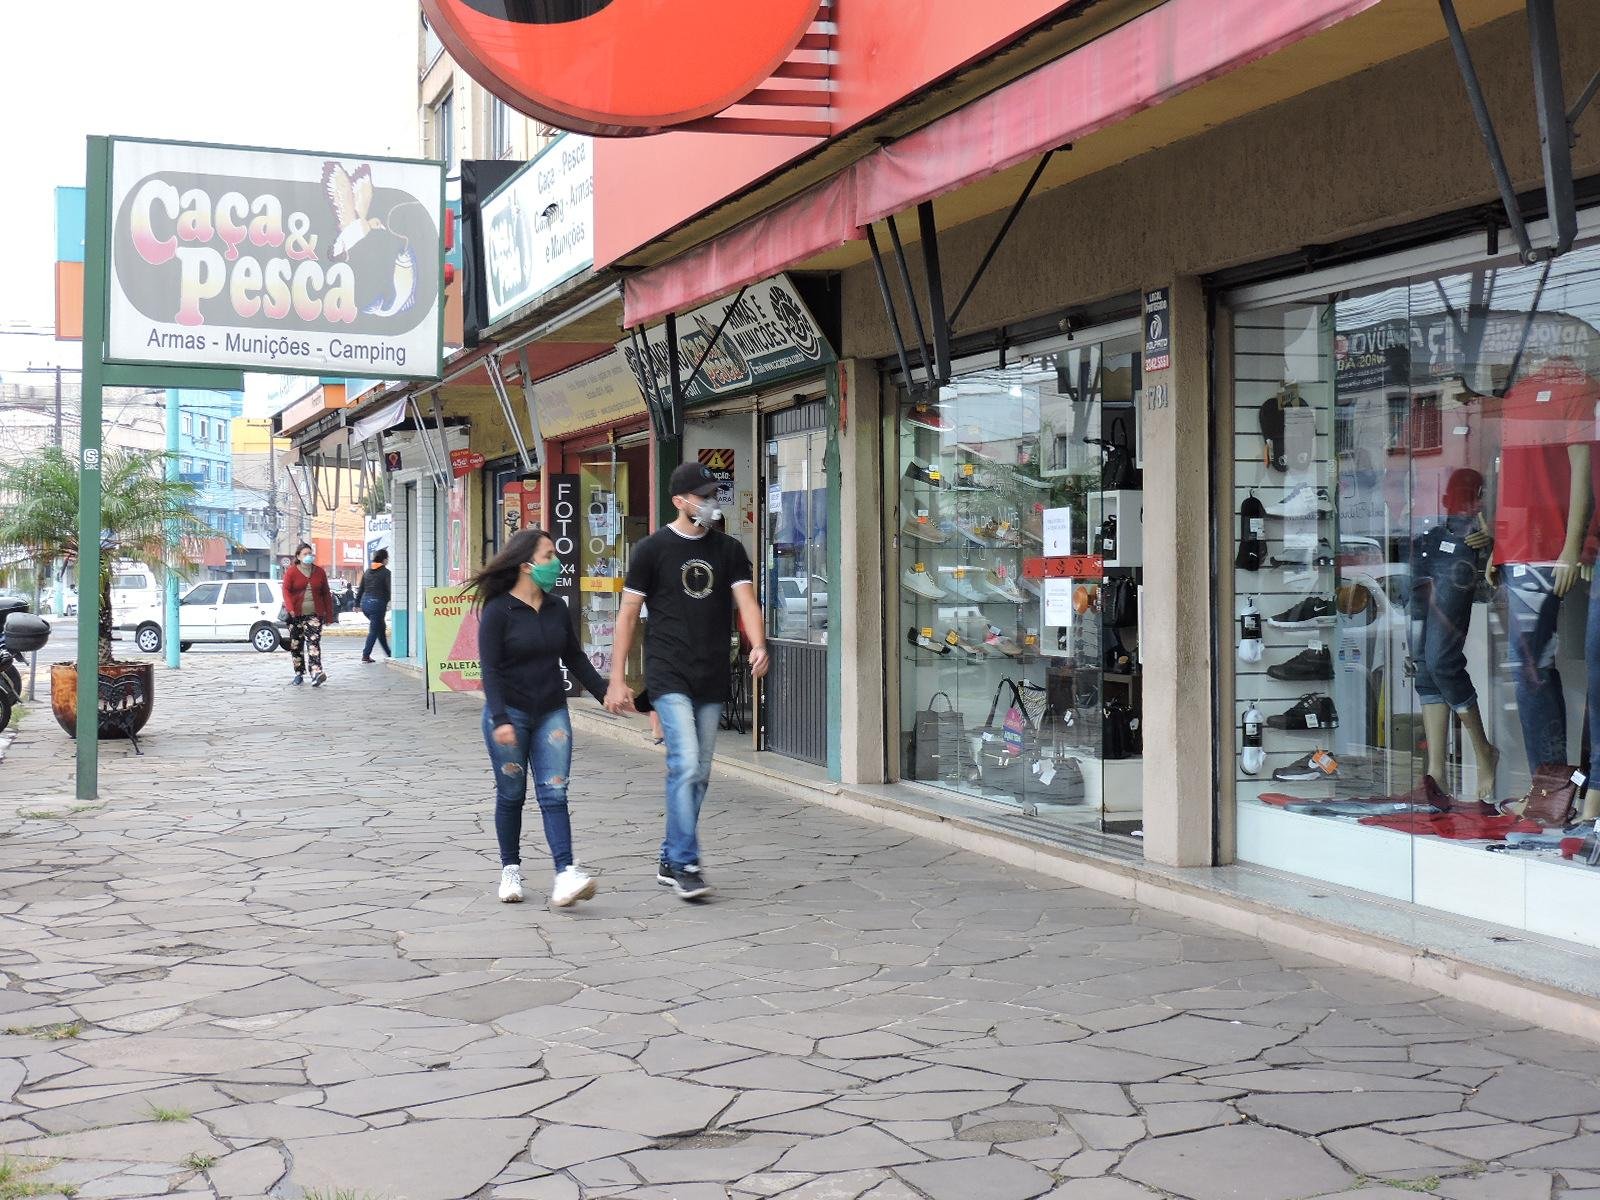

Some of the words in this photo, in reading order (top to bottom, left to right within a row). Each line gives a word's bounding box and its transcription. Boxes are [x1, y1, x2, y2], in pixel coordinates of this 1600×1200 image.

[562, 142, 585, 176] Pesca
[570, 175, 594, 209] Armas
[131, 179, 285, 264] Caça
[285, 211, 318, 261] &
[551, 221, 585, 259] Munições
[174, 246, 358, 326] Pesca
[750, 294, 767, 319] E
[147, 328, 206, 351] Armas
[226, 331, 311, 359] Munições
[329, 339, 407, 366] Camping
[733, 320, 788, 357] MUNIÇÕES
[555, 484, 574, 555] FOTO
[433, 594, 478, 605] COMPR
[555, 577, 572, 587] EM
[433, 607, 461, 616] AQUI
